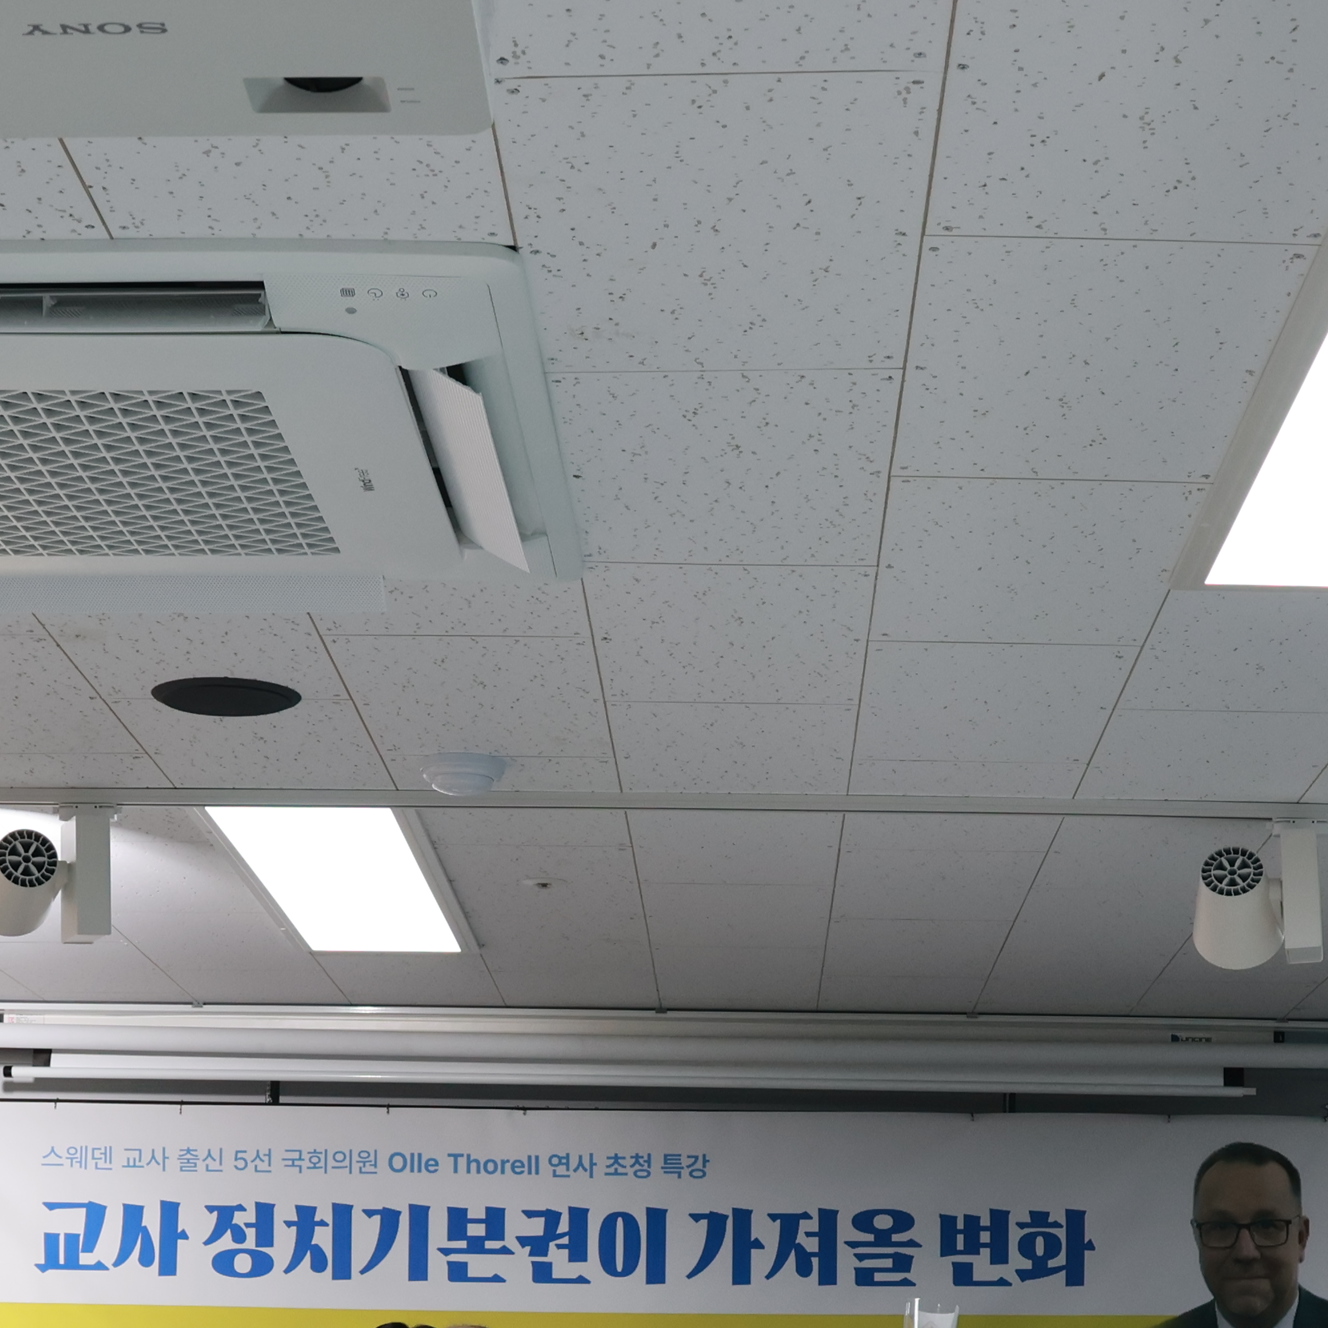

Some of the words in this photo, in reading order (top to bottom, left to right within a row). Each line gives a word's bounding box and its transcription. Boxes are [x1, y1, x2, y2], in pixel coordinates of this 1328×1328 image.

[22, 21, 168, 36] SONY
[41, 1145, 113, 1172] 스웨덴
[122, 1147, 170, 1173] 교사
[177, 1147, 225, 1174] 출신
[233, 1149, 273, 1174] 5선
[281, 1148, 379, 1176] 국회의원
[387, 1150, 441, 1175] Olle
[447, 1152, 542, 1176] Thorell
[547, 1152, 599, 1179] 연사
[604, 1152, 654, 1180] 초청
[660, 1153, 712, 1180] 특강
[35, 1200, 190, 1277] 교사
[202, 1200, 670, 1286] 정치기본권이
[684, 1207, 924, 1288] 가져올
[938, 1208, 1097, 1288] 변화
